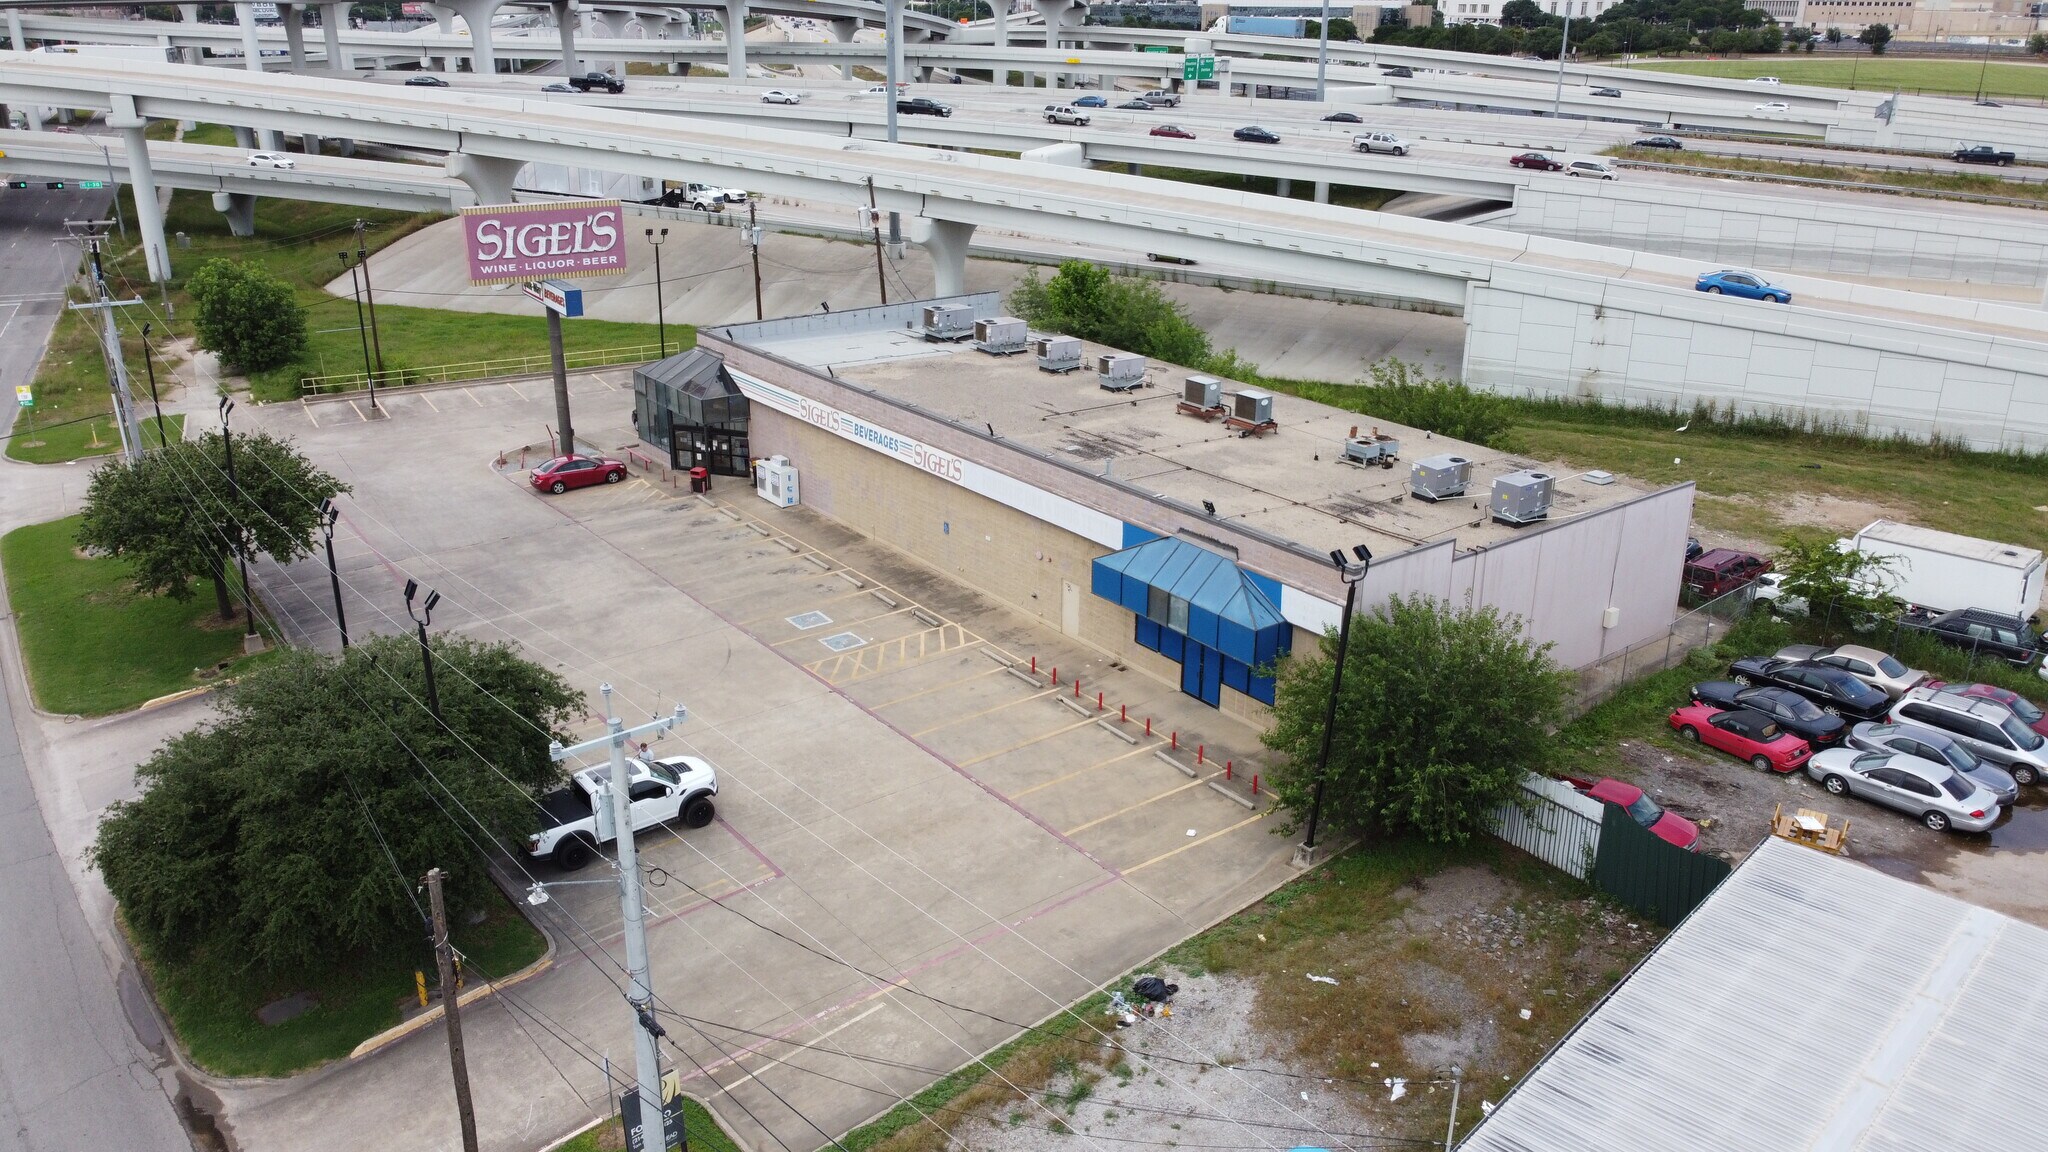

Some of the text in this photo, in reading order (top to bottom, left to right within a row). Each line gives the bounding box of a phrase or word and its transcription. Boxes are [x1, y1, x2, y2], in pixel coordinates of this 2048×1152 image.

[476, 211, 617, 261] SIGEL'S
[480, 255, 618, 274] WINE LIQUOR BEER
[800, 399, 962, 482] SIGEL'S BEVERAGES SIGEL'S
